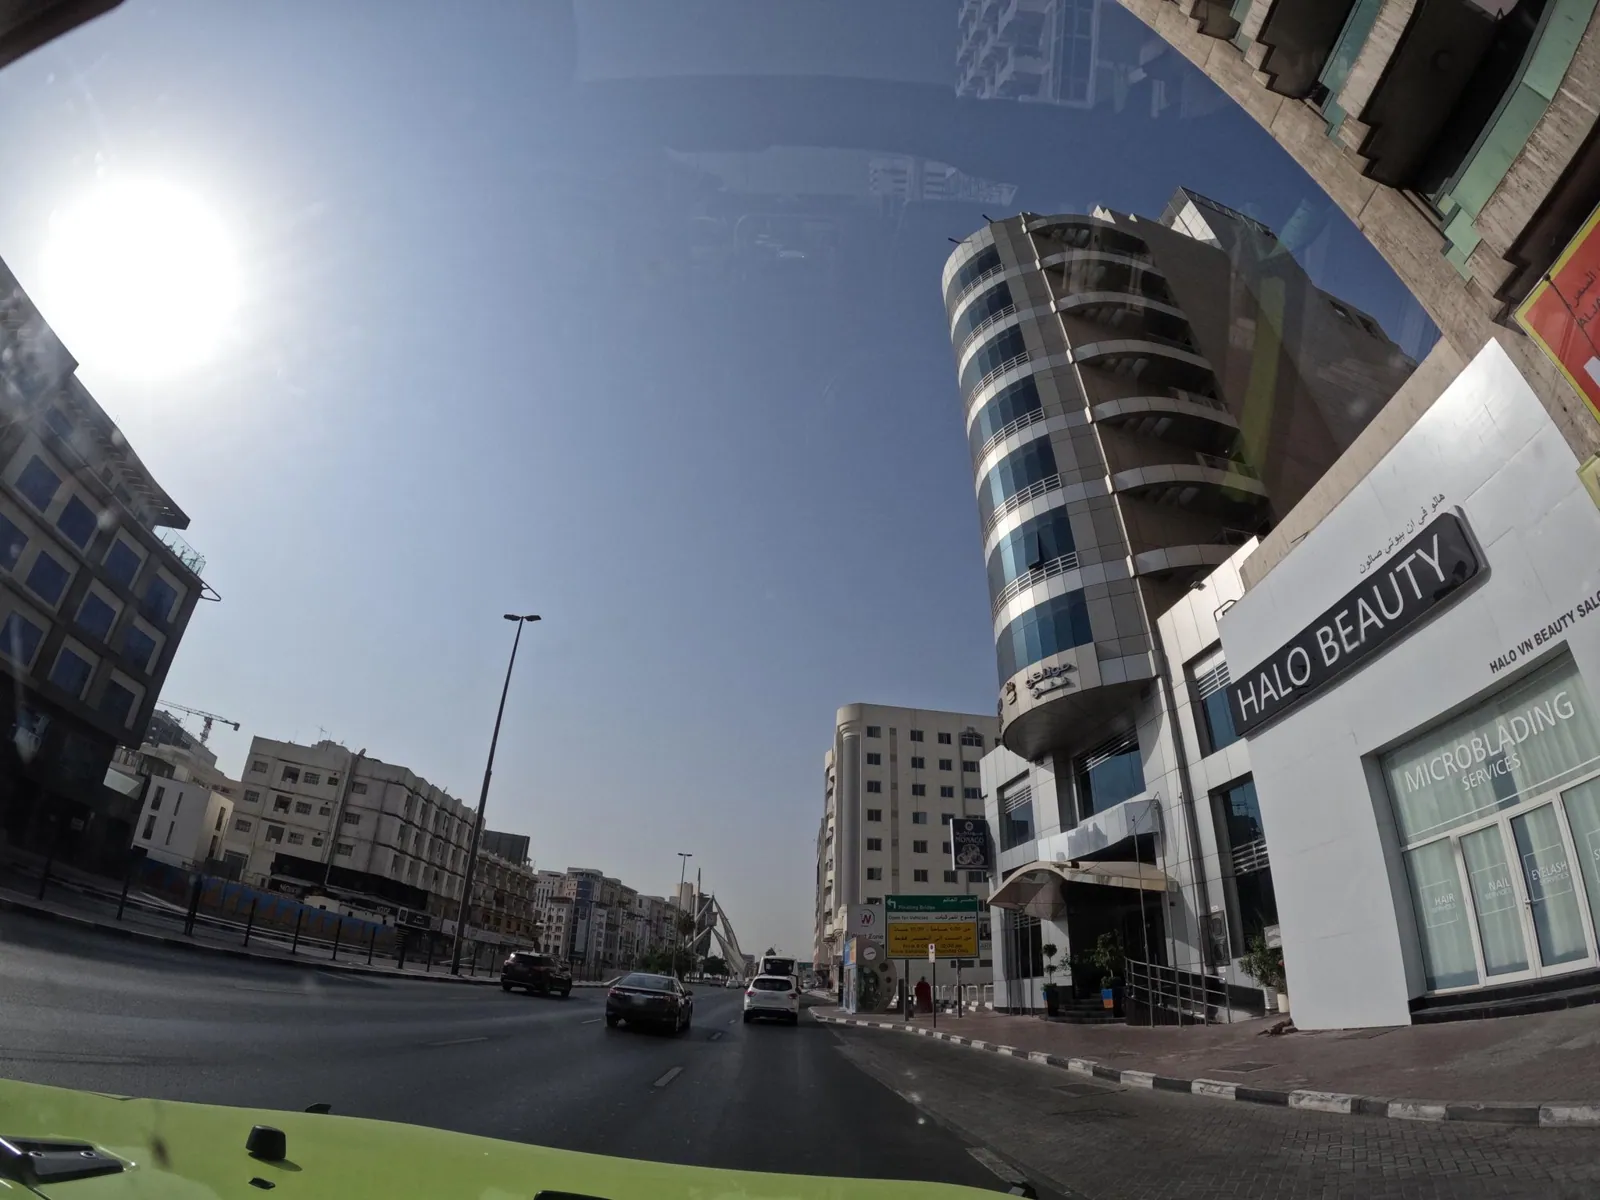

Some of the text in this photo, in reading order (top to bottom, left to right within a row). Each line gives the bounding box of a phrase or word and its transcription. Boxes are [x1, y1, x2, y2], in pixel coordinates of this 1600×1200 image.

[1236, 533, 1447, 721] HALO BEAUTY
[1489, 650, 1517, 674] HALO
[1517, 639, 1534, 657] VN
[1534, 609, 1575, 646] BEAUTY
[1404, 691, 1576, 793] MICROBLADING
[1461, 752, 1522, 791] SERVICES
[1488, 878, 1511, 890] NAIL
[1531, 861, 1569, 881] EYELASH
[1434, 893, 1455, 905] HAIR
